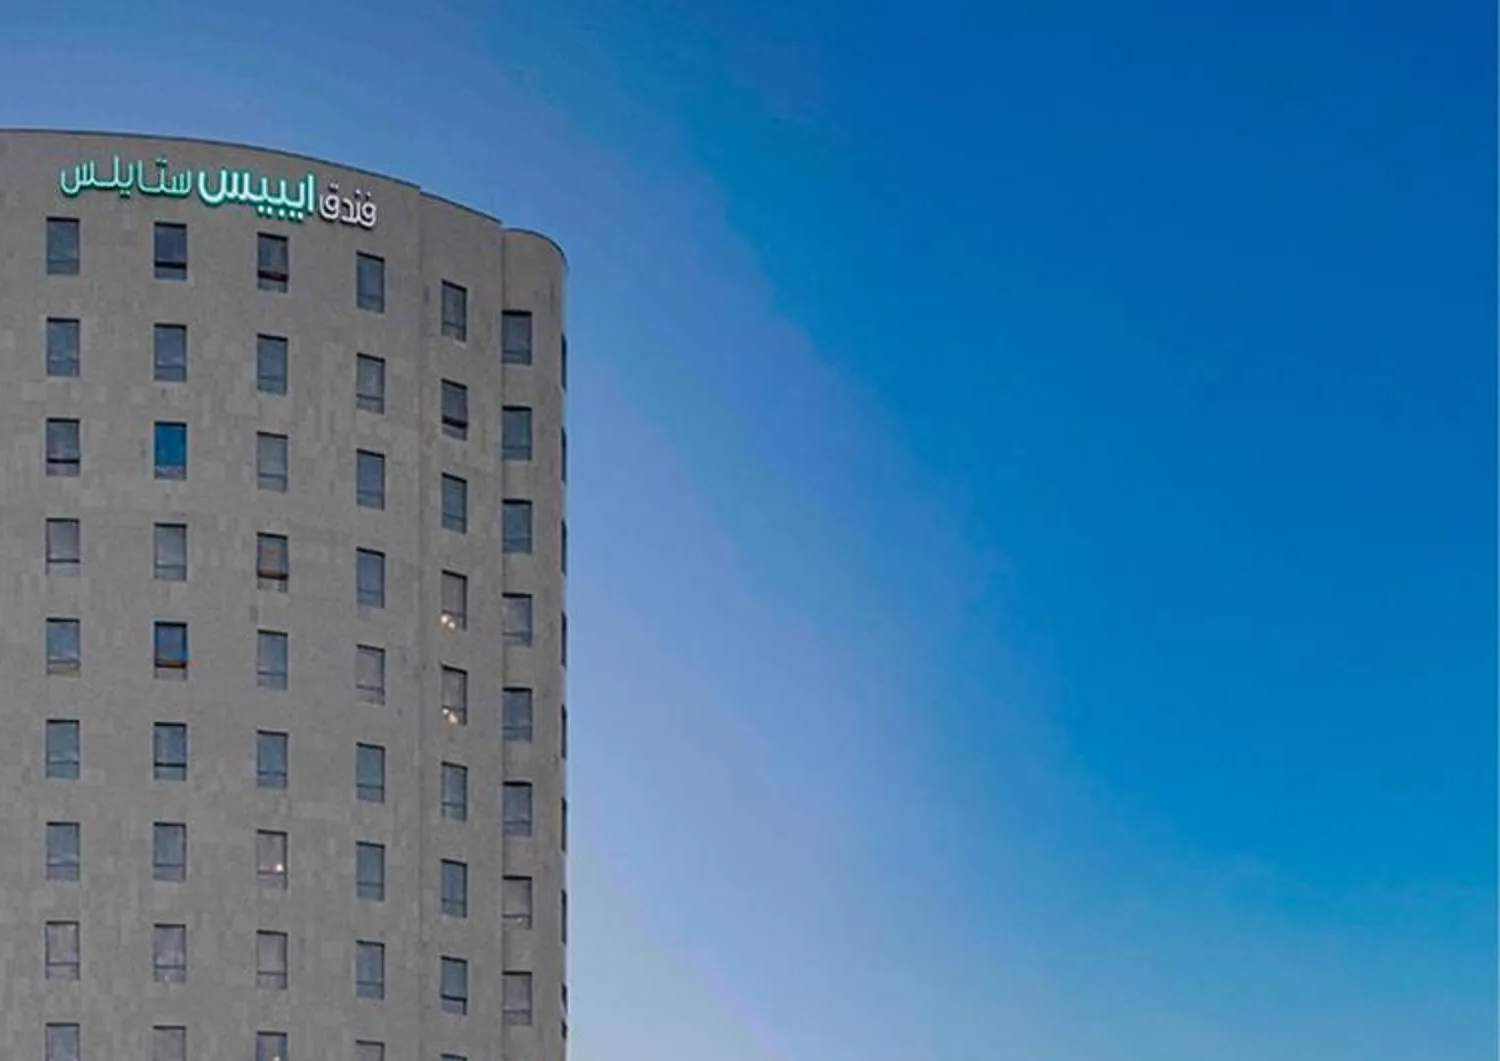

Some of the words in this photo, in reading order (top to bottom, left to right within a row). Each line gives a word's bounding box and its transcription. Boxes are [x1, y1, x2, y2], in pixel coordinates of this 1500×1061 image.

[60, 154, 192, 197] ستايلس
[199, 167, 317, 219] ايبيس
[318, 183, 377, 227] فندق
